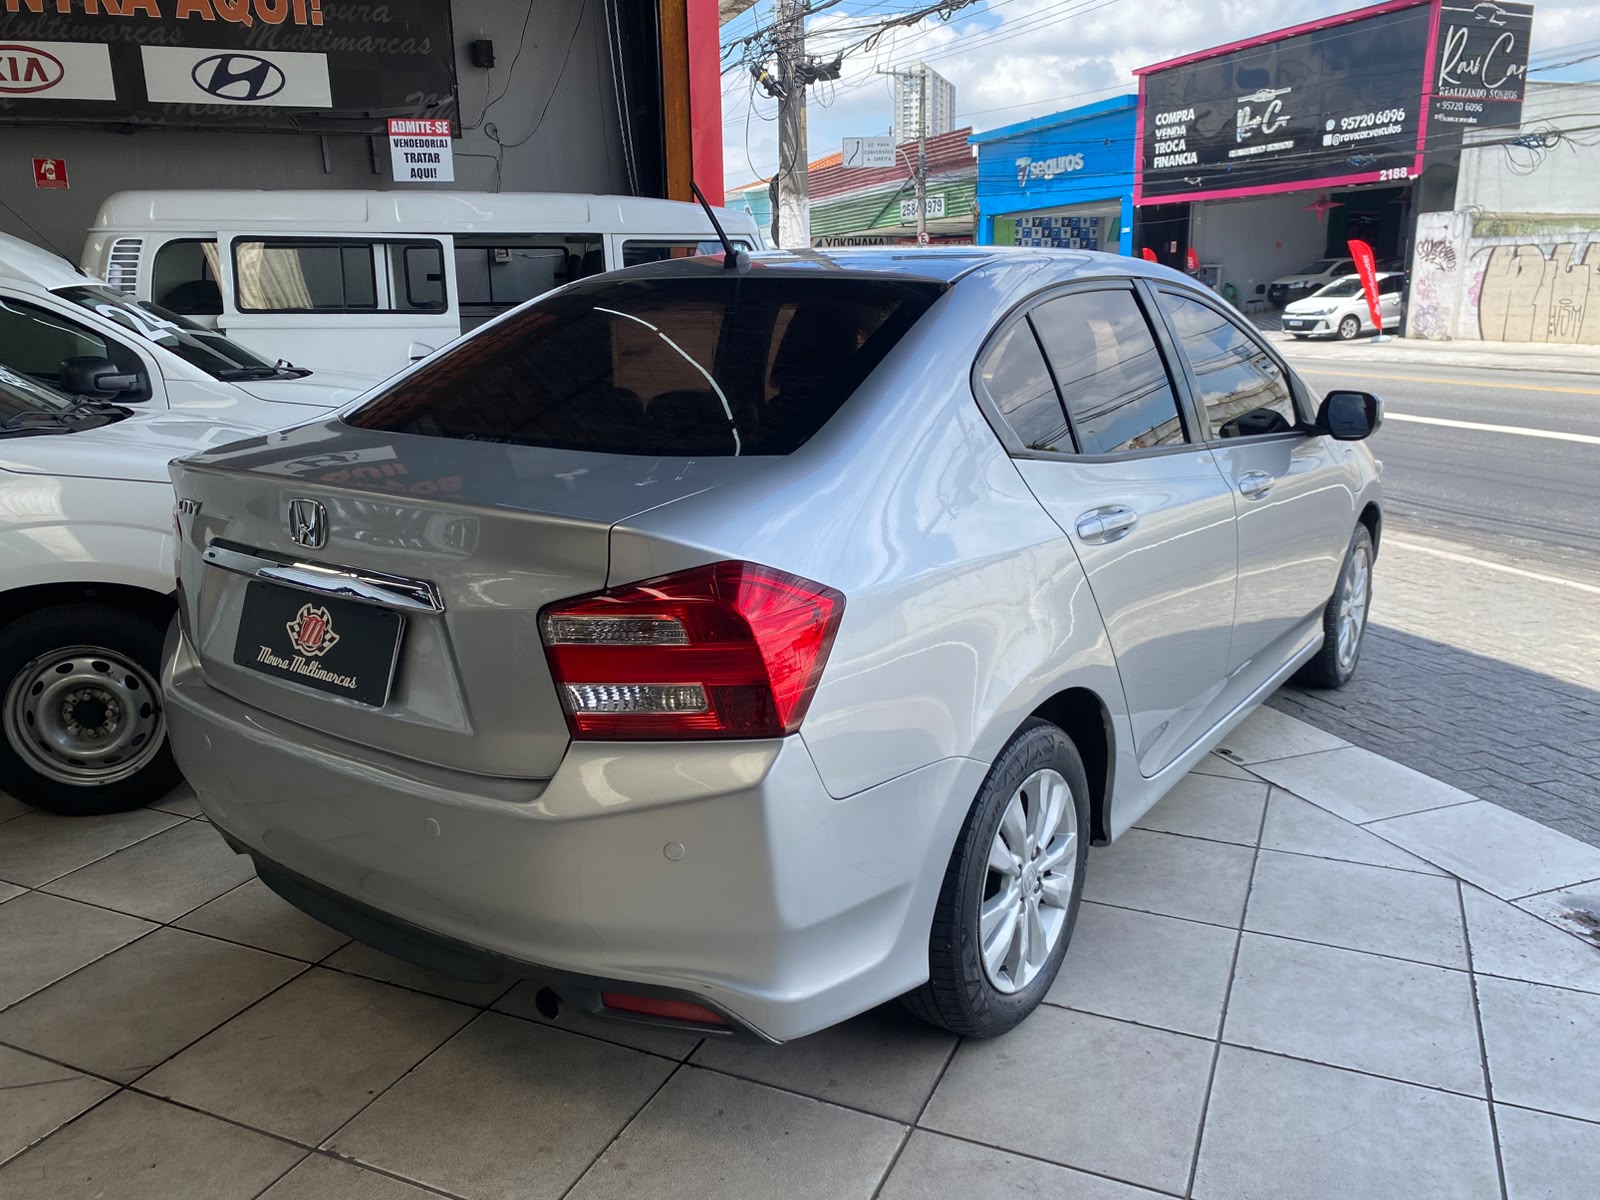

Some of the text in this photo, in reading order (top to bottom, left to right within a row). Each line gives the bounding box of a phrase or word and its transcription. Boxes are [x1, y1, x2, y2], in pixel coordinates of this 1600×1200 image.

[1482, 31, 1527, 89] Car
[1441, 101, 1483, 112] 95720 6096
[1155, 108, 1195, 126] COMPRA
[1340, 108, 1406, 130] 95720 6096
[391, 120, 449, 134] ADMITE-SE
[1155, 124, 1187, 140] VENDA
[393, 138, 448, 148] VENDEDOR(A)
[1154, 139, 1187, 155] TROCA
[403, 152, 441, 163] TRATAR
[1030, 152, 1085, 179] seguros
[1153, 151, 1198, 169] FINANCIA
[410, 167, 437, 179] AQUI!
[1379, 167, 1408, 181] 2188
[257, 645, 358, 689] Moura Multimarcas
